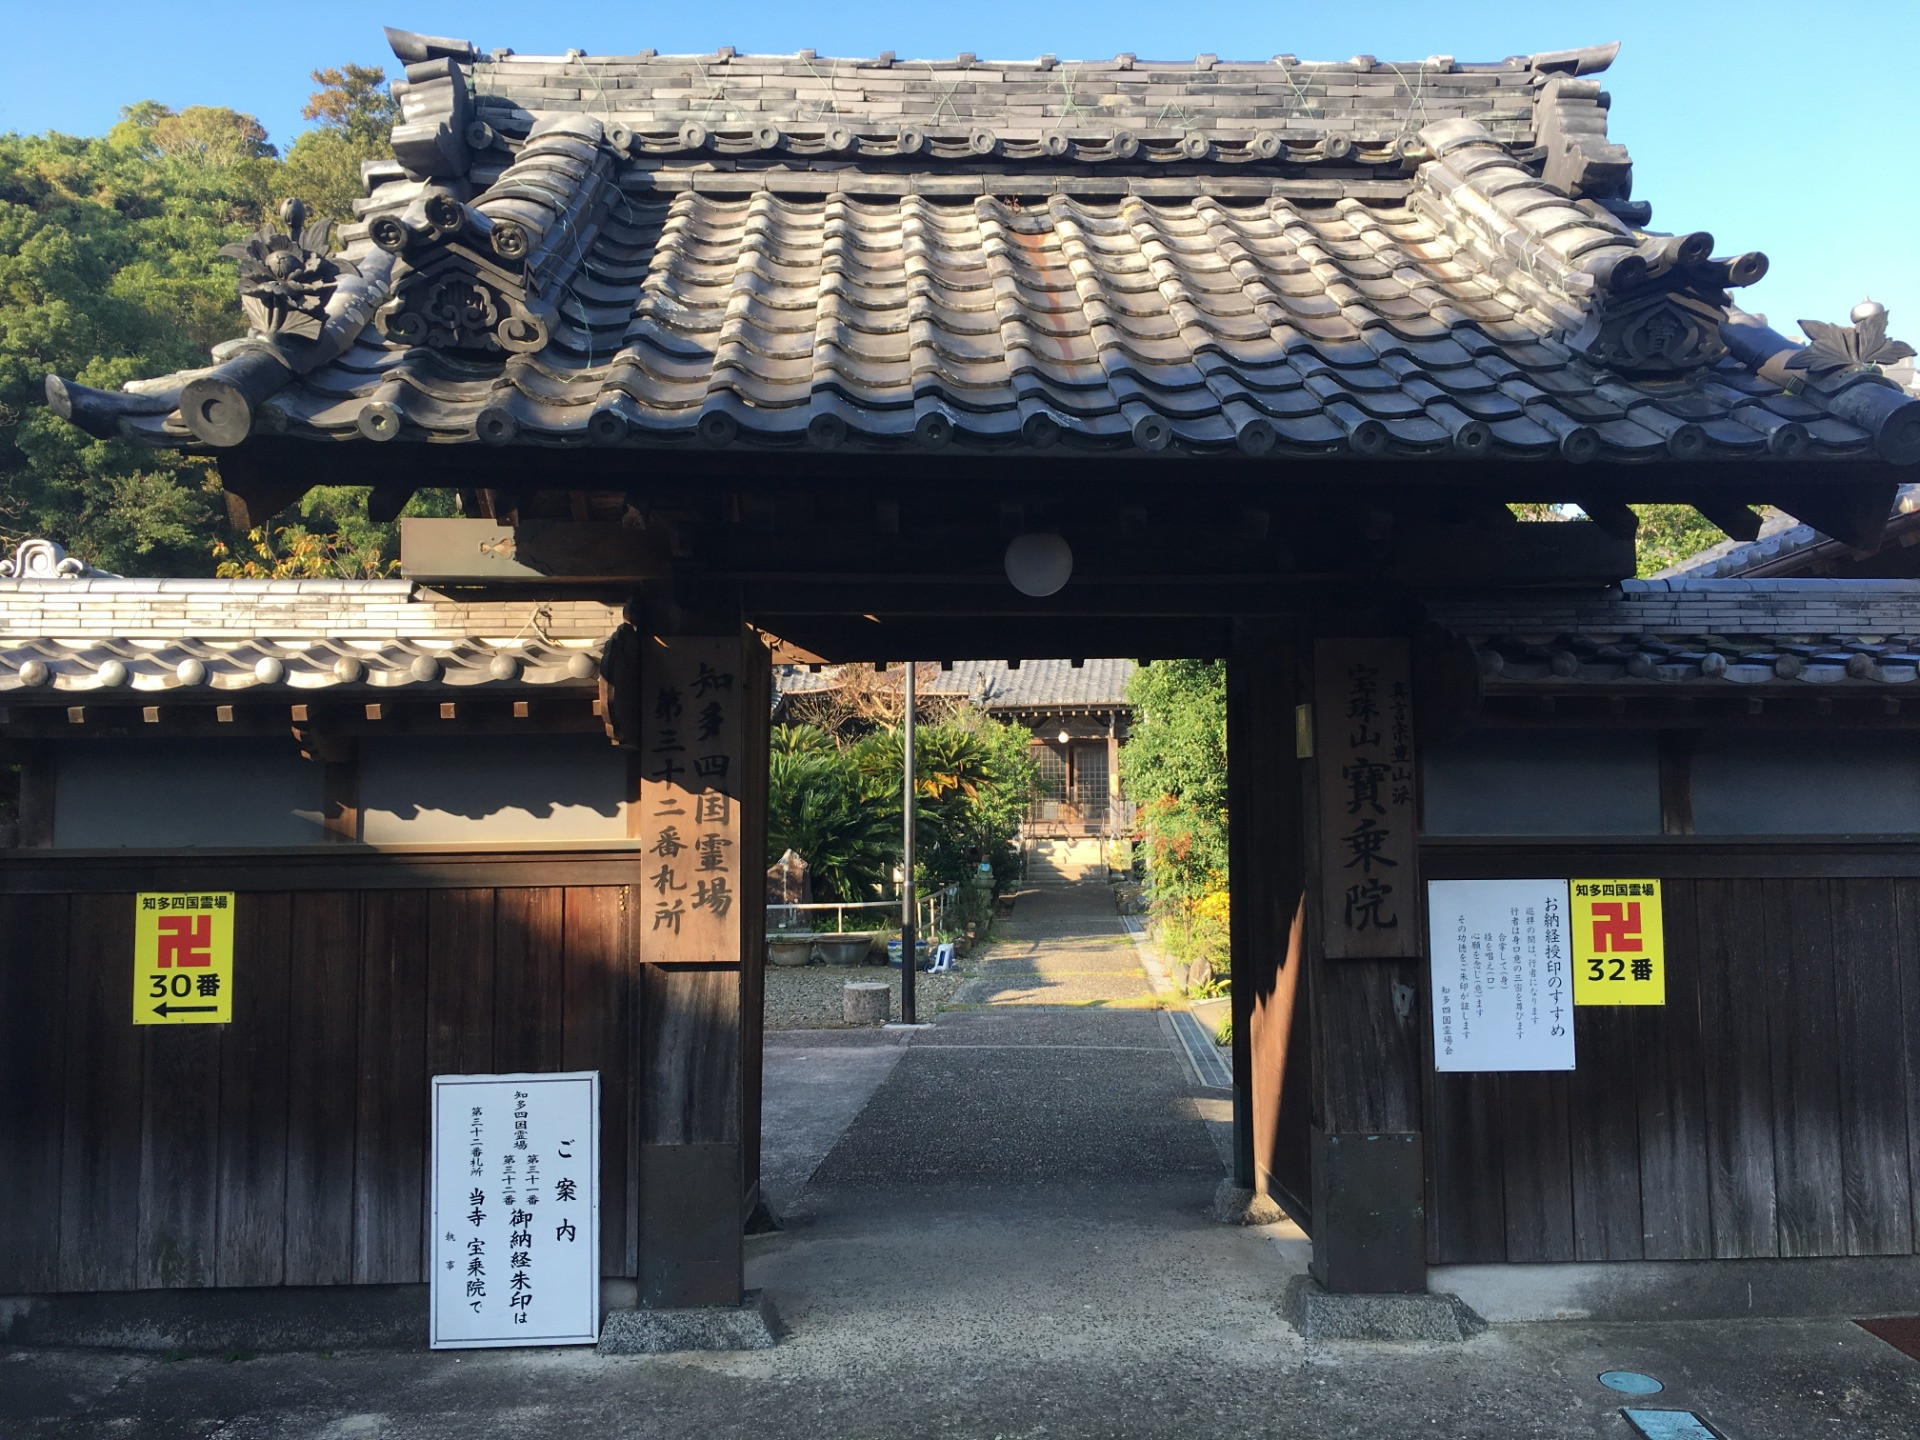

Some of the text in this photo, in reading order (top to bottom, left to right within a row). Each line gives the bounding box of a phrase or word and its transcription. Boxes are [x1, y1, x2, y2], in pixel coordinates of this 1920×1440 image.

[650, 686, 688, 935] 第三十二番札所
[689, 662, 733, 918] 知多四国霊場
[143, 896, 228, 910] 知多四国霊場
[1576, 884, 1654, 896] 知多四国霊場
[149, 973, 220, 998] 30番
[1543, 897, 1566, 1037] お納経授印のすすめ
[1587, 958, 1653, 981] 32番
[1441, 986, 1454, 1055] 知多四国霊場会
[470, 1107, 484, 1178] 第三十二番札所
[513, 1091, 528, 1150] 知多四国霊場
[502, 1154, 516, 1205] 第三十二番
[526, 1154, 540, 1205] 第三十一番
[555, 1139, 577, 1243] ご案内
[509, 1208, 533, 1324] 御納経朱印は
